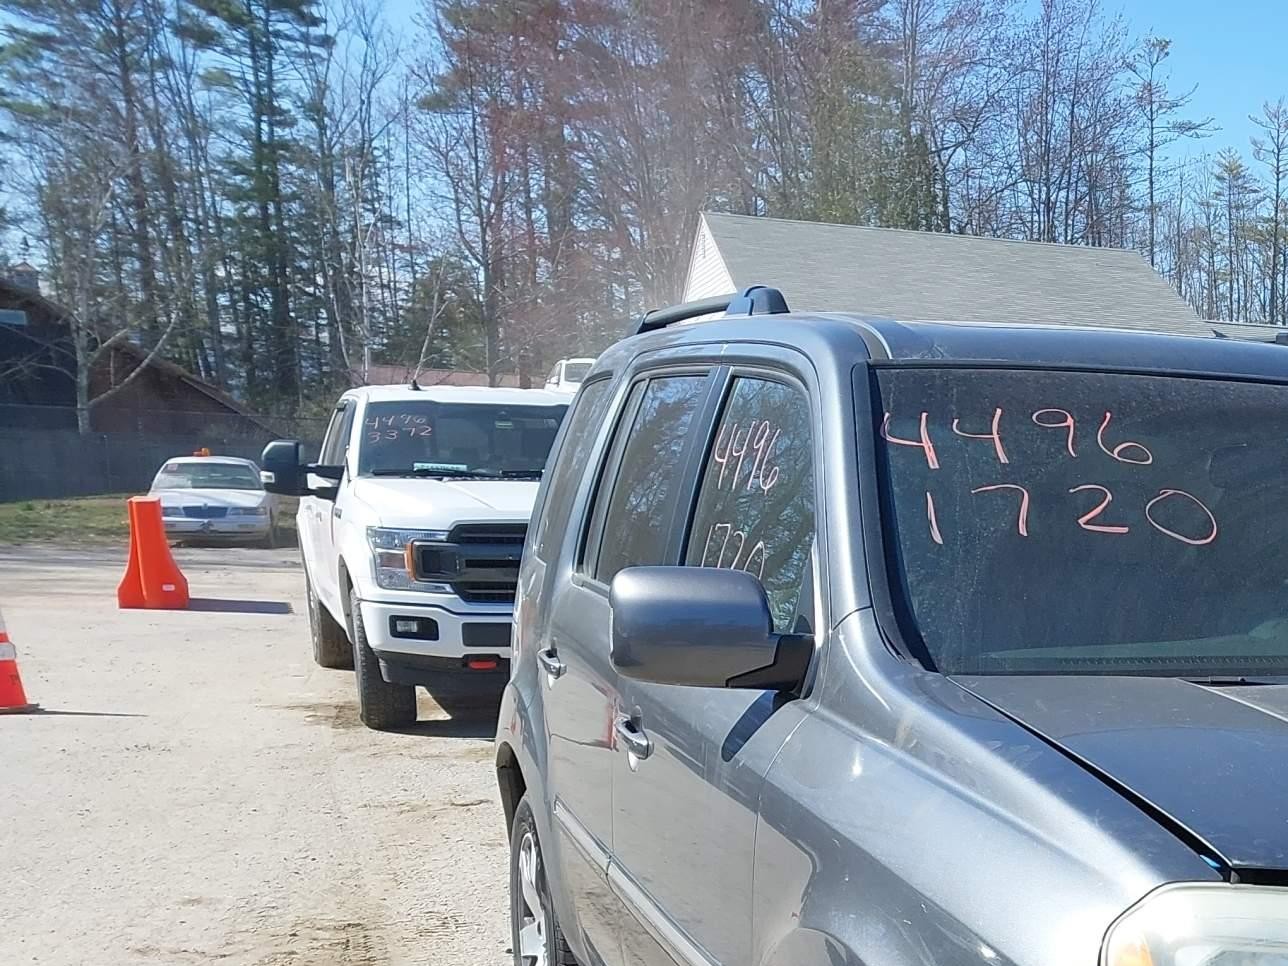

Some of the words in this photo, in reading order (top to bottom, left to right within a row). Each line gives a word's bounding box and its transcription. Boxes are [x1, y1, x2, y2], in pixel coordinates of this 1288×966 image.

[367, 426, 433, 446] 3372
[714, 420, 782, 495] 4496
[881, 408, 1152, 470] 4496
[926, 483, 1218, 545] 1720
